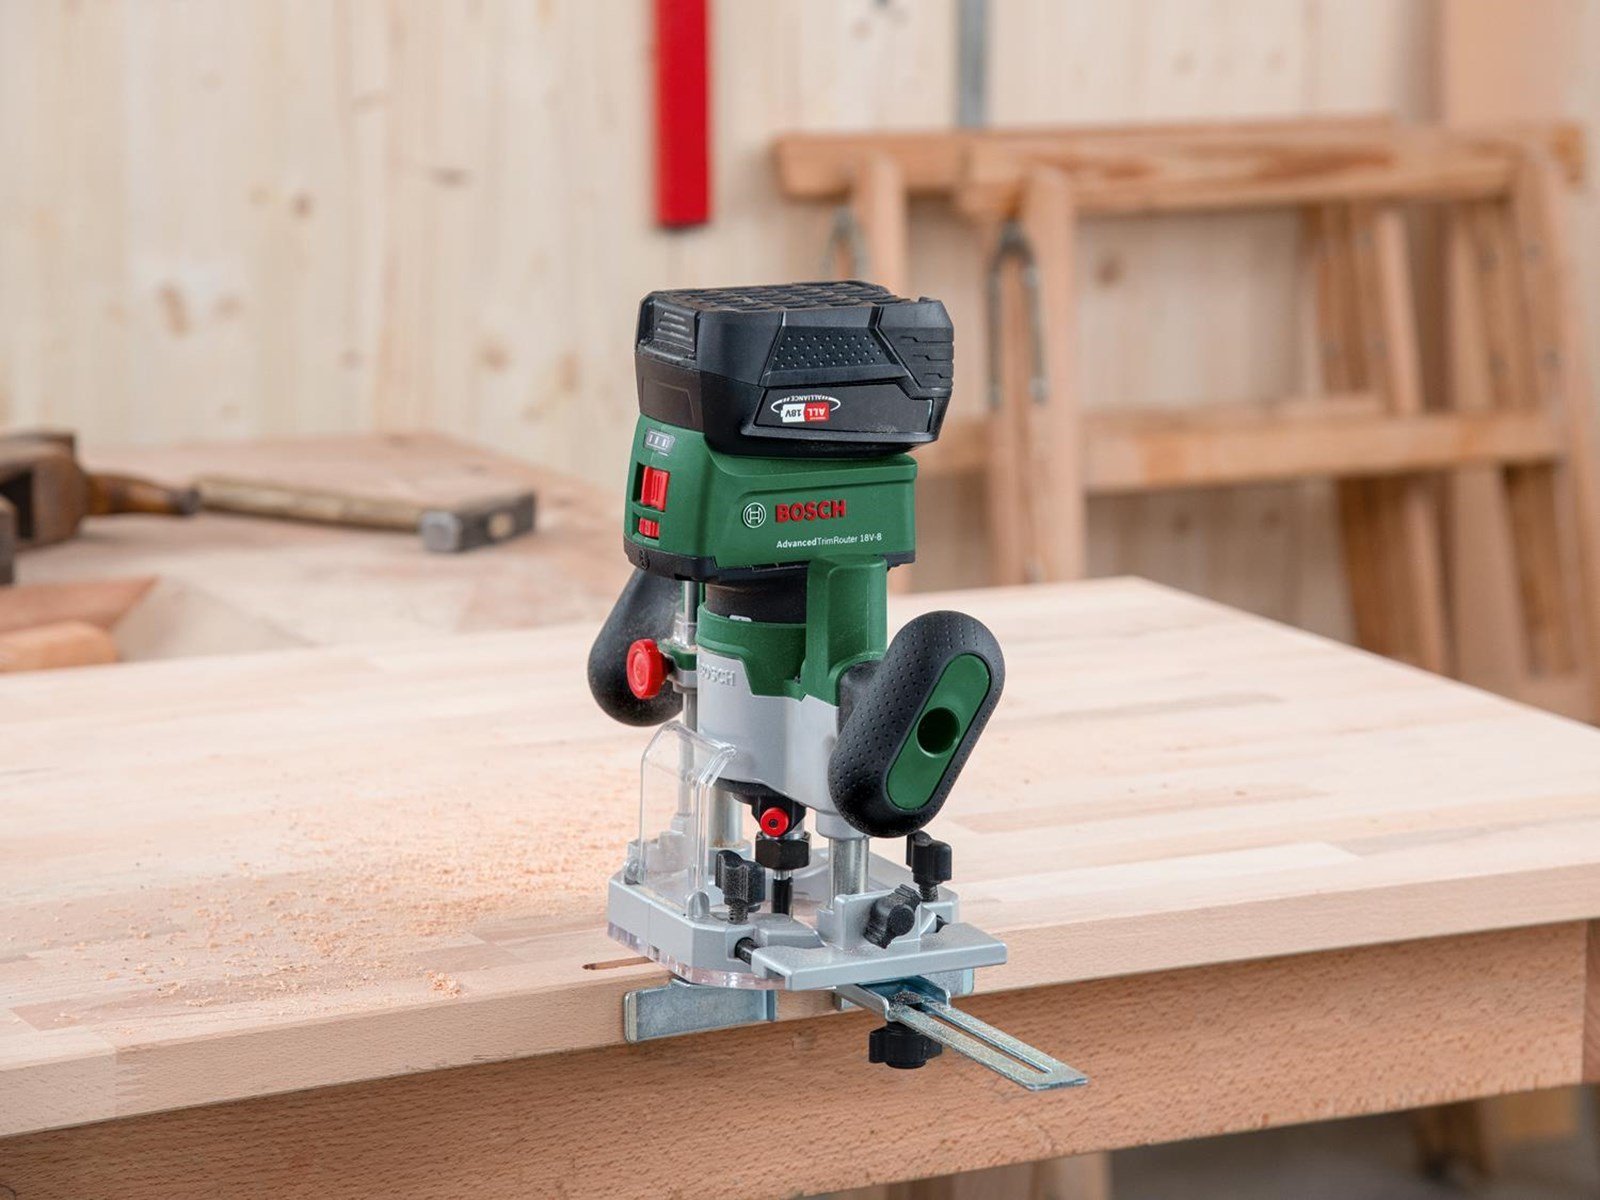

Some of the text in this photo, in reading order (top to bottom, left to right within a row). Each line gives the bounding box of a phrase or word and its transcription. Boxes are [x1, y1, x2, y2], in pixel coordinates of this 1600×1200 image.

[791, 394, 821, 402] ALLIANCE
[785, 408, 826, 418] ALL 18V
[775, 500, 847, 523] BOSCH
[776, 532, 882, 549] AdvancedTrimRouter 18V-8
